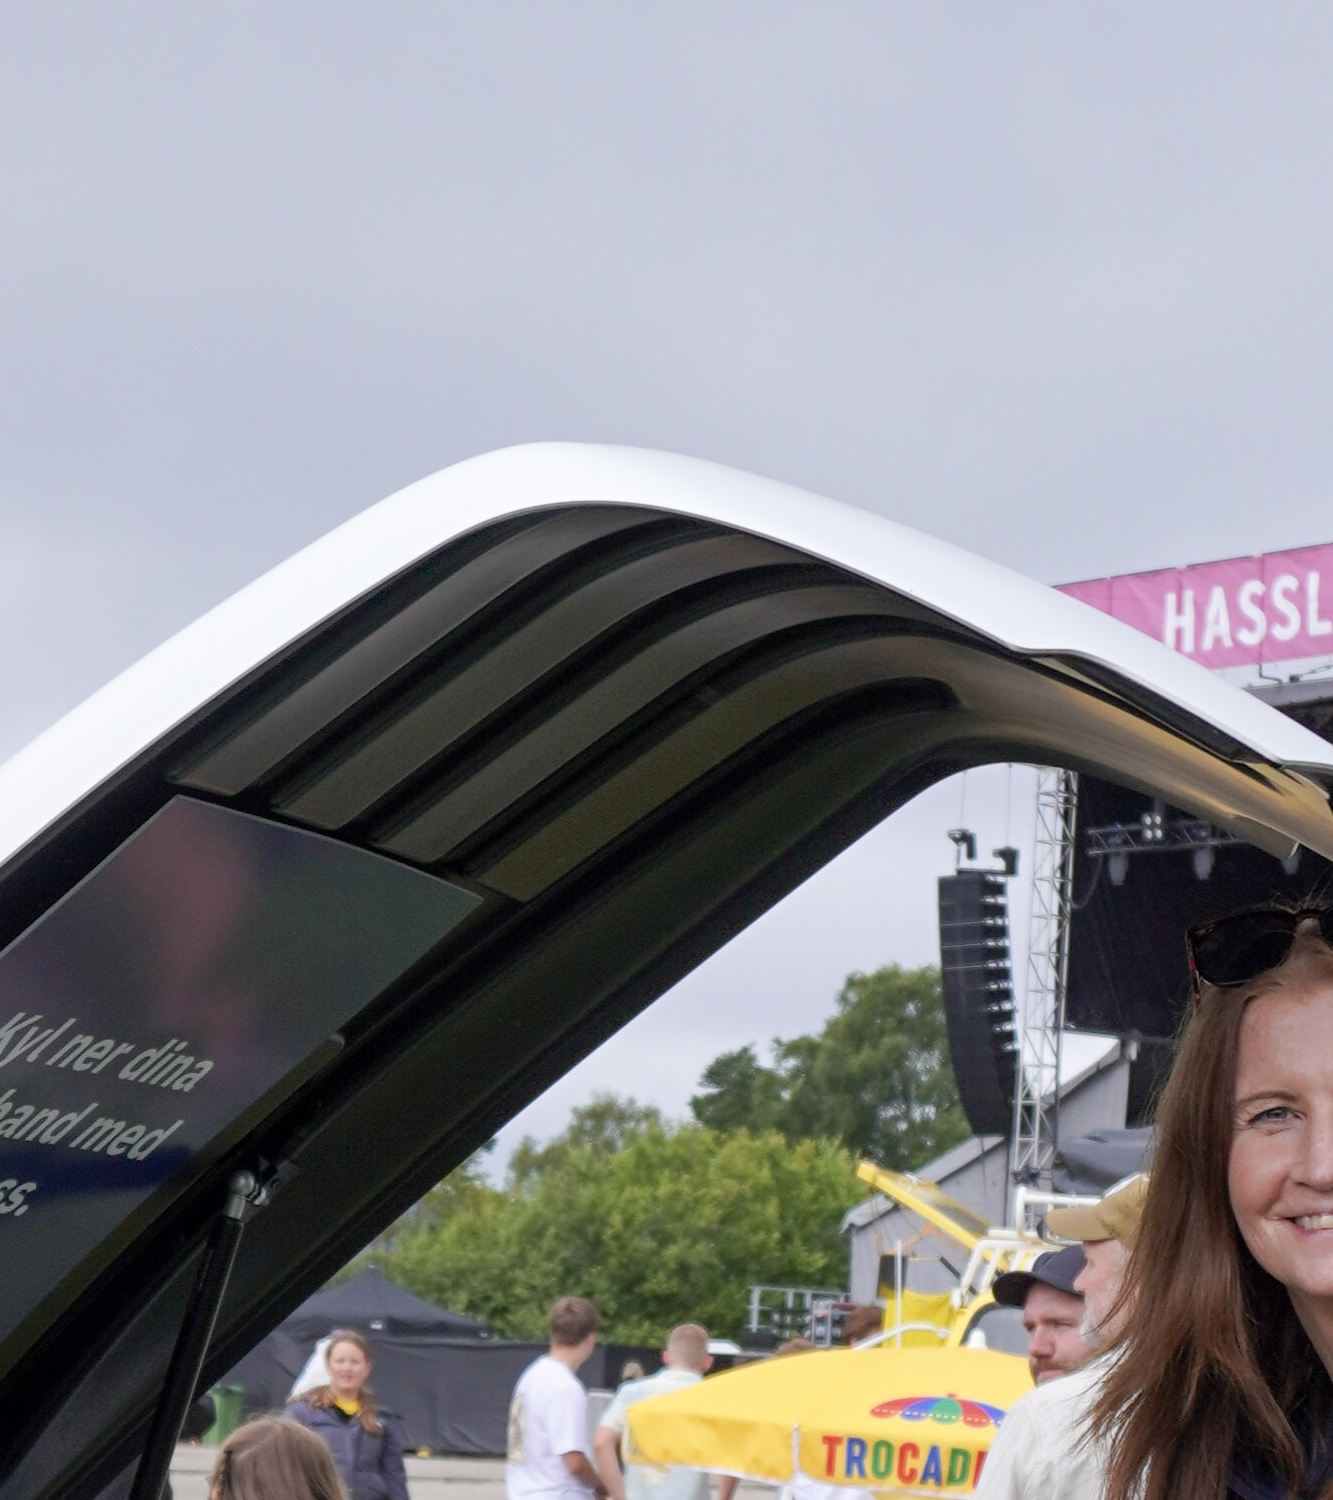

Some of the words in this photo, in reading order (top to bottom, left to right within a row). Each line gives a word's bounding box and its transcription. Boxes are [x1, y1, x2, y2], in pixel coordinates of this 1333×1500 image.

[45, 1033, 135, 1075] ner
[117, 1038, 214, 1093] dina
[68, 1118, 185, 1161] med
